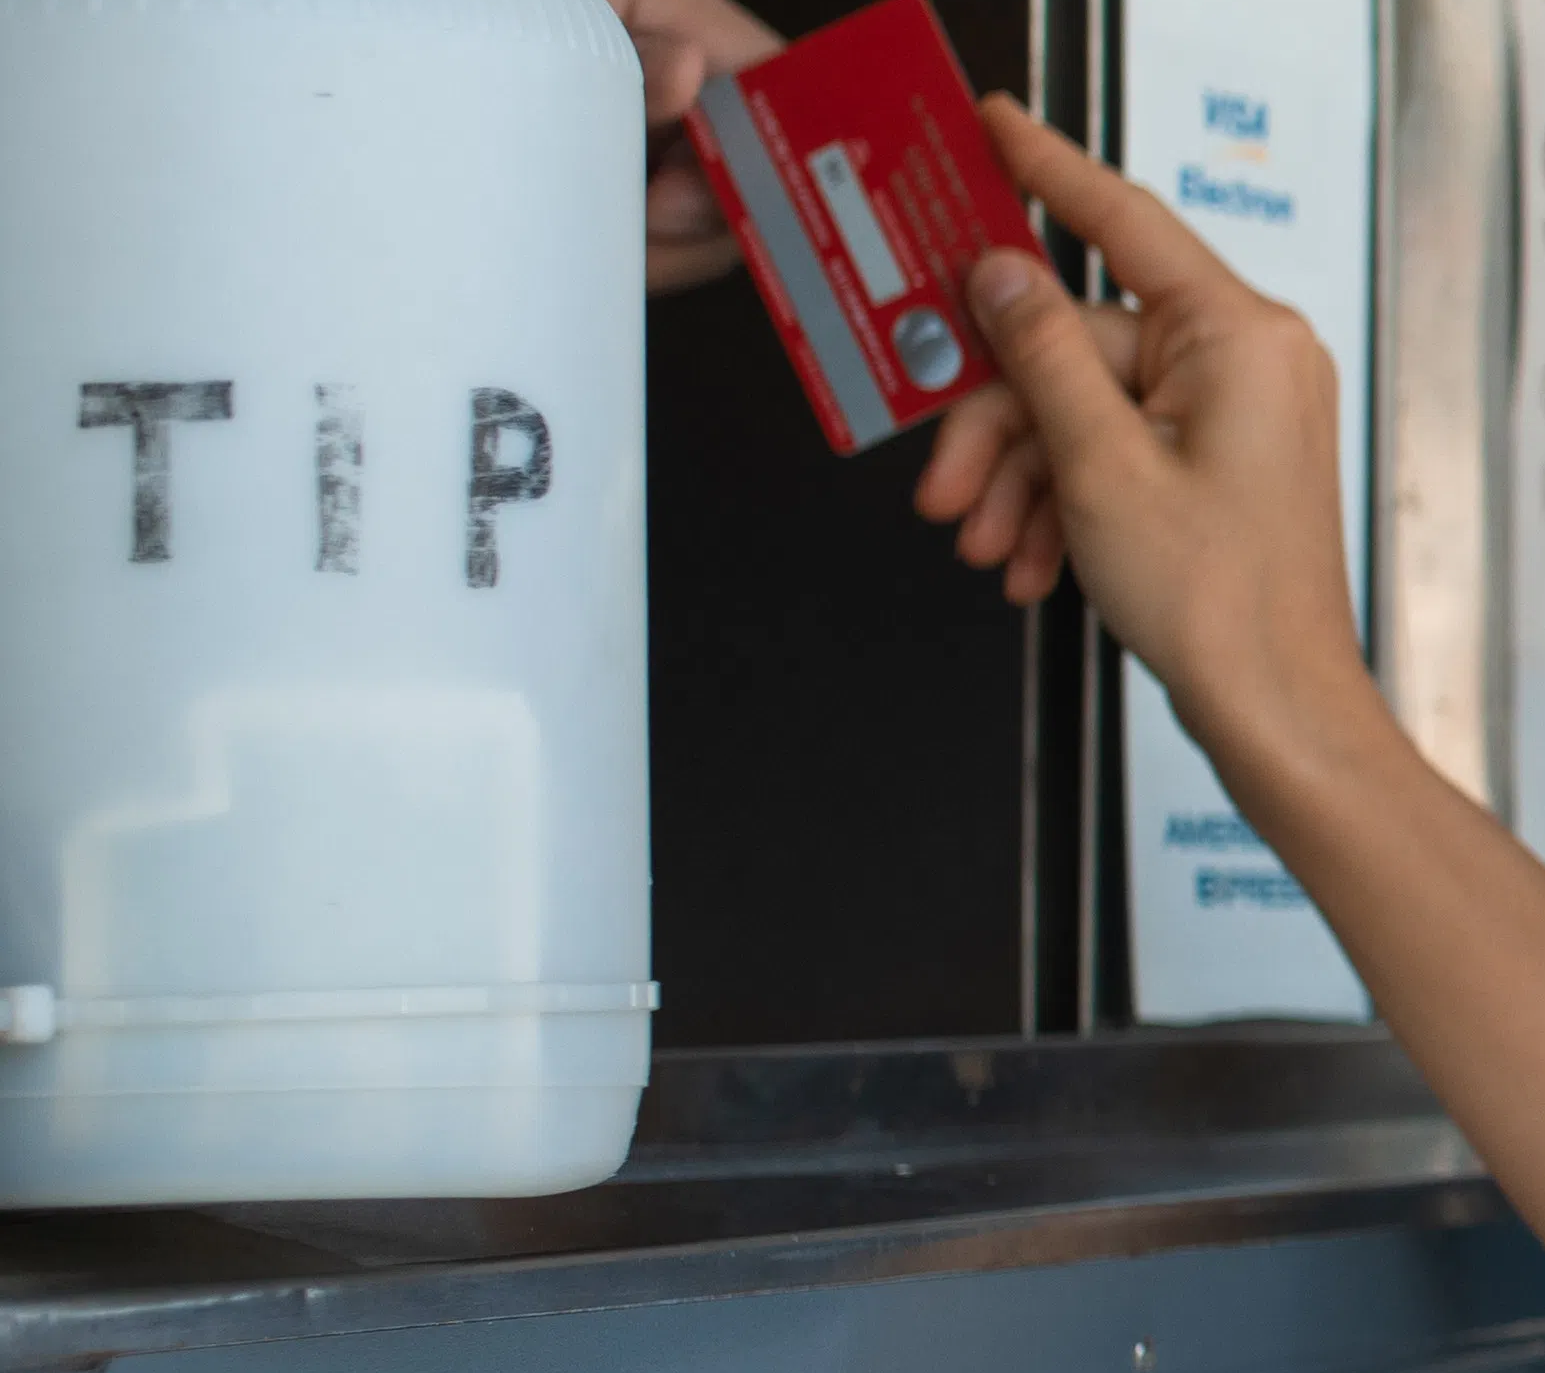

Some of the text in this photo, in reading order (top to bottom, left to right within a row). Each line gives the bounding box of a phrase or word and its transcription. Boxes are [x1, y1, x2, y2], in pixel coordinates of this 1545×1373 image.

[1203, 89, 1269, 142] VISA
[1177, 164, 1294, 222] Electron
[77, 379, 553, 588] TIP
